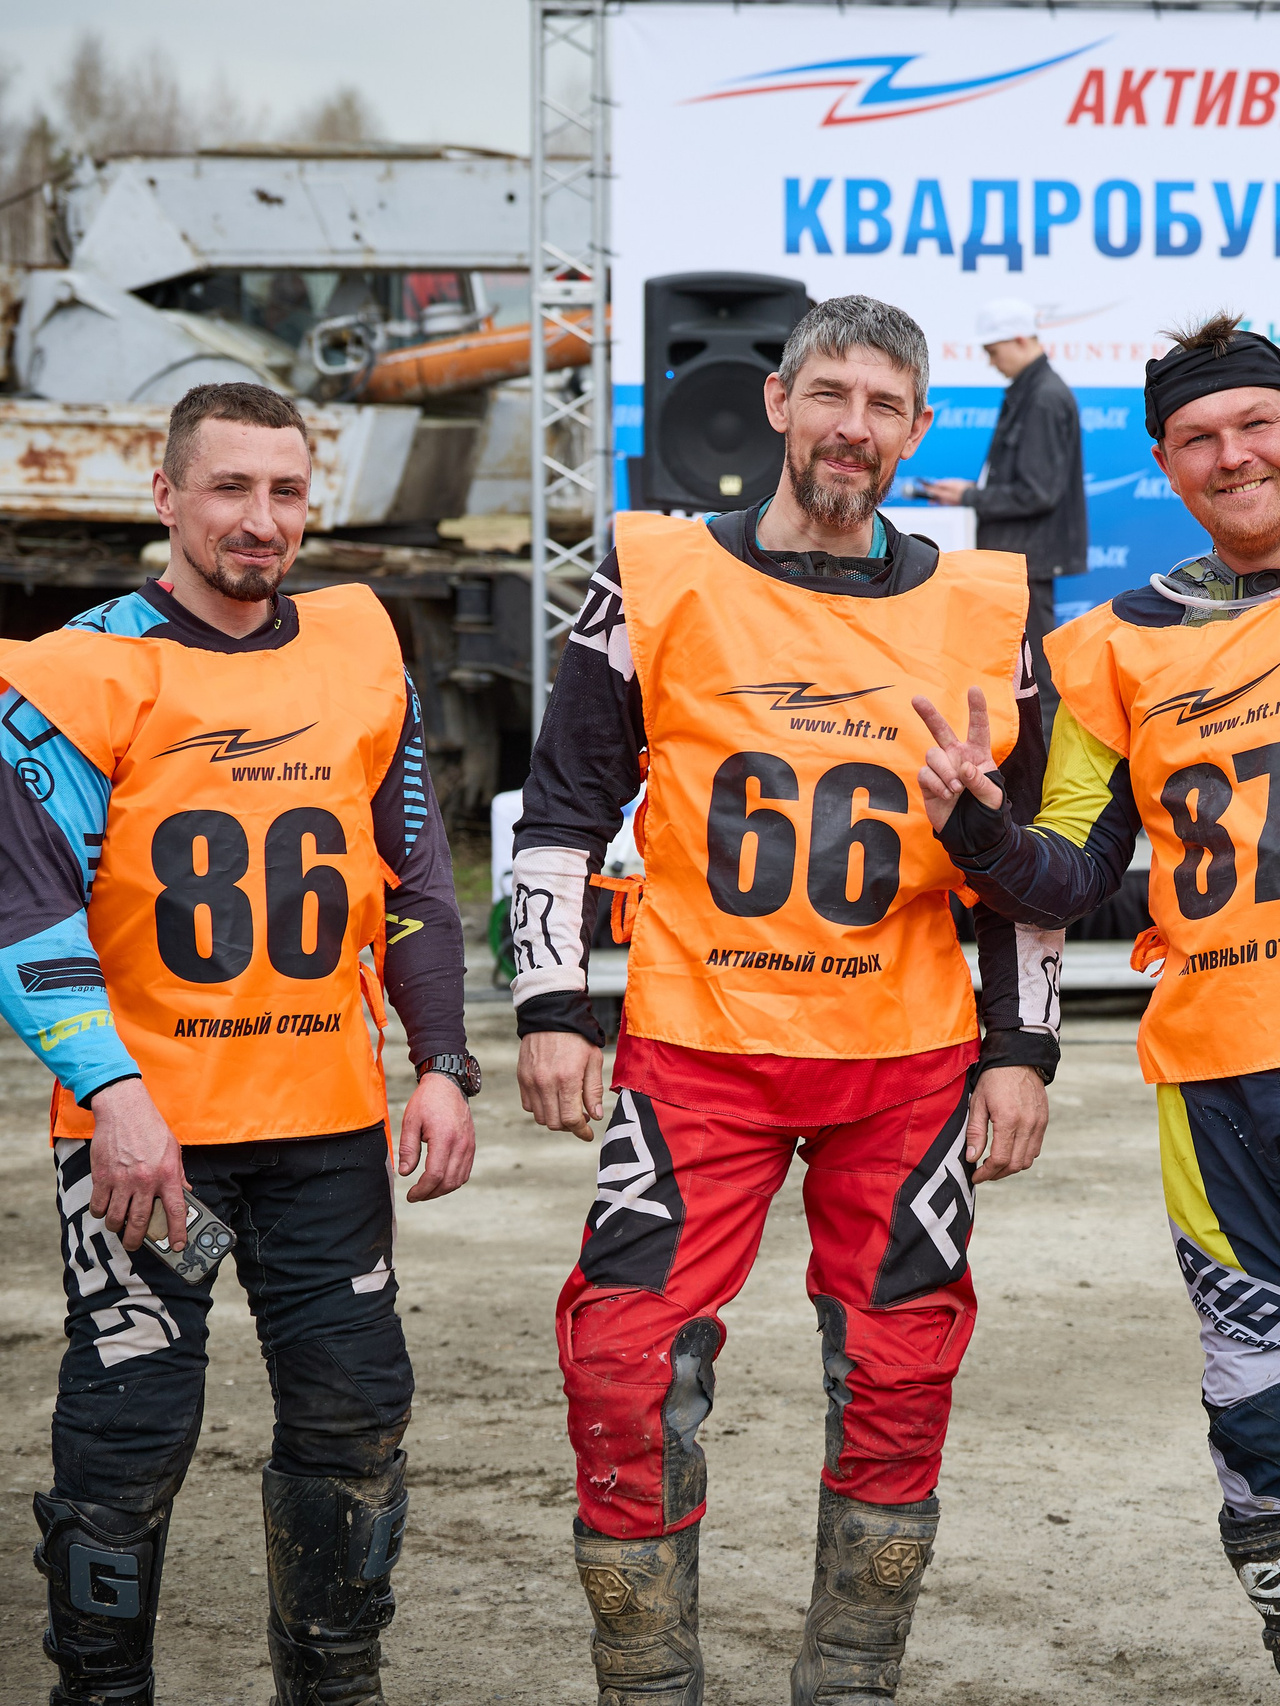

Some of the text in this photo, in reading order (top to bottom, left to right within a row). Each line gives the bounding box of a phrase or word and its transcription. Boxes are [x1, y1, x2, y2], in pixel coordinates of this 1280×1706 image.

[789, 717, 899, 741] www.hft.ru
[231, 762, 331, 782] www.hft.ru
[706, 751, 909, 927] 66
[151, 806, 350, 984] 86
[706, 948, 883, 979] АКТИВНЫЙ ОТДЫХ
[174, 1011, 342, 1038] АКТИВНЫЙ ОТДЫХ
